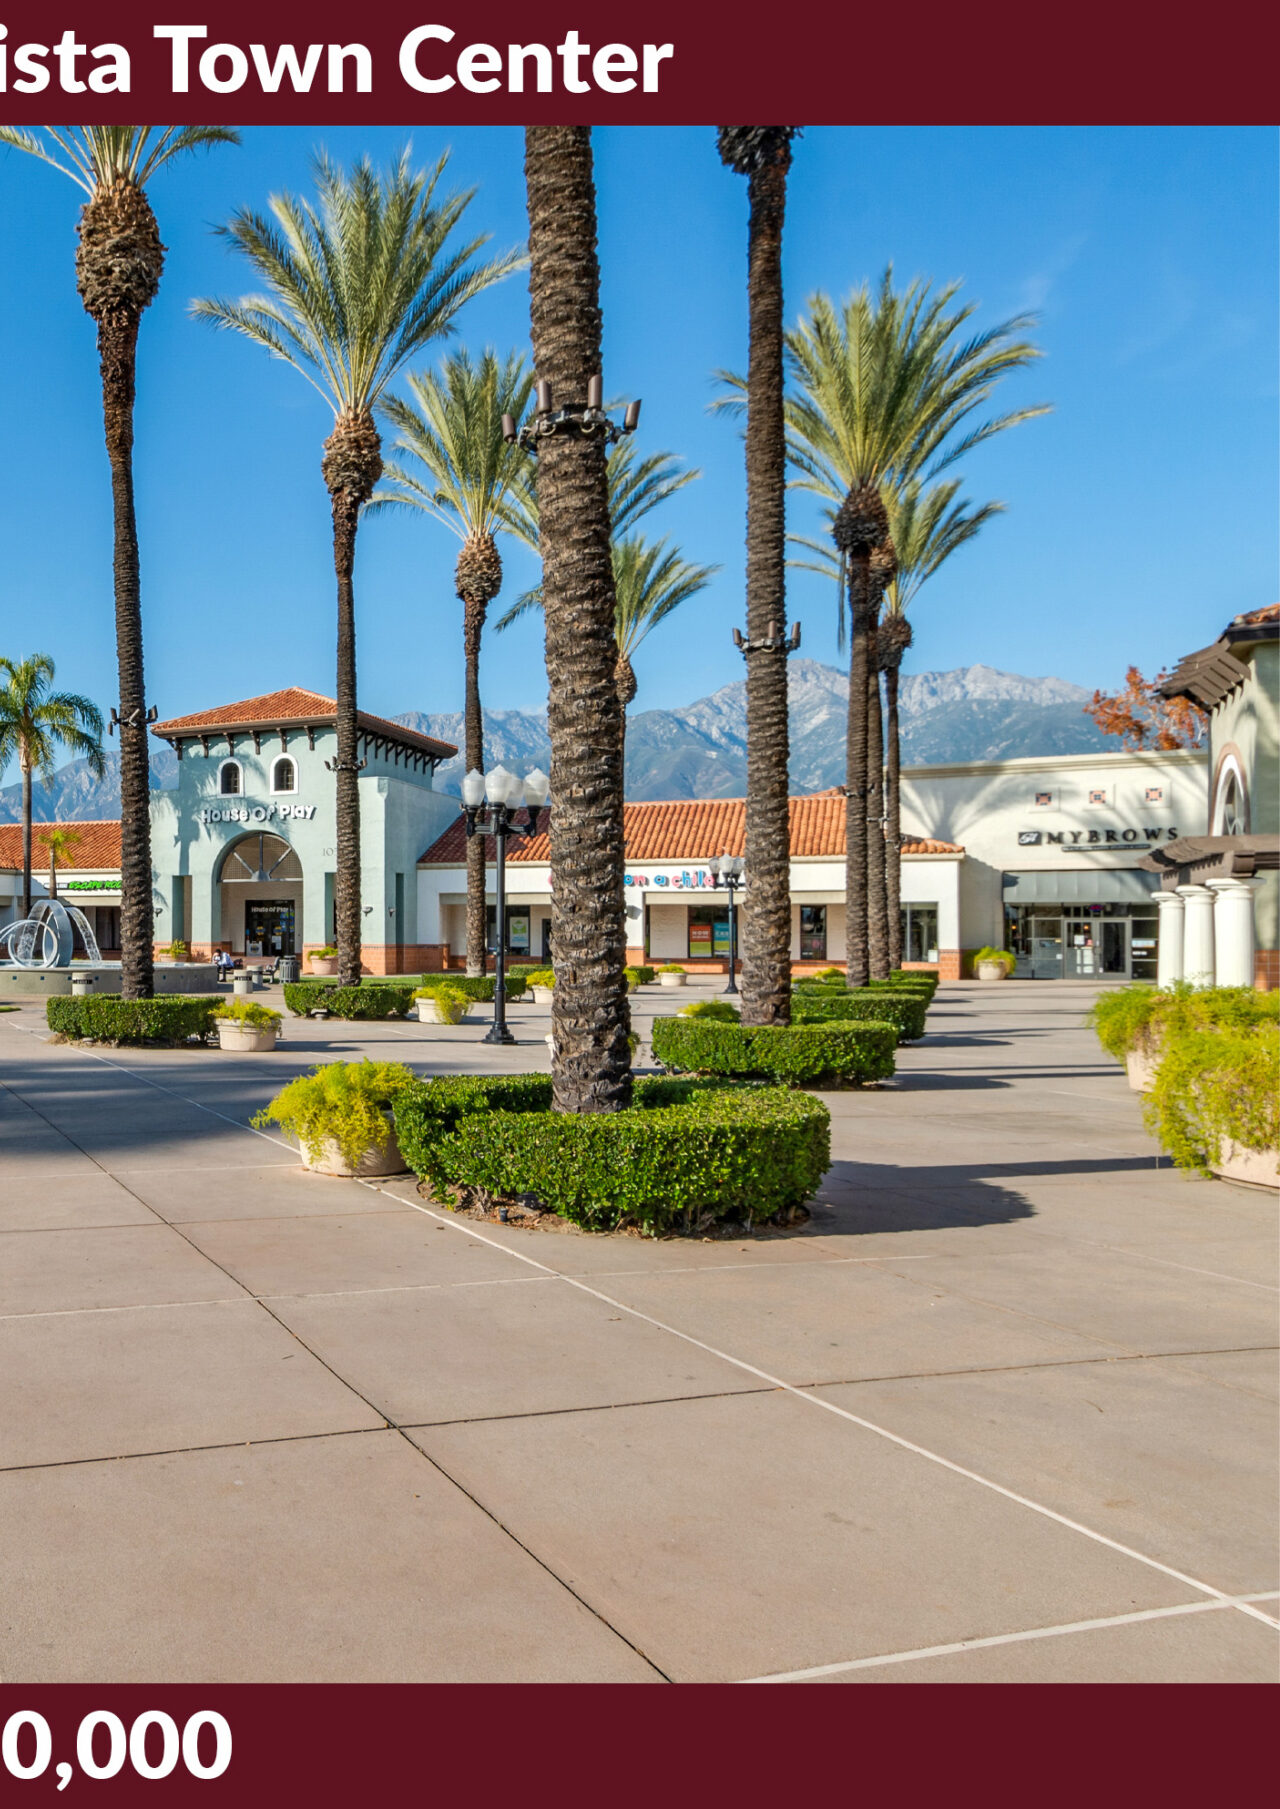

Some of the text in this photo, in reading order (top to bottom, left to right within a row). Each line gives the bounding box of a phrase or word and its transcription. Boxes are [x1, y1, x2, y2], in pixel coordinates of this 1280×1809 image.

[201, 808, 248, 823] House
[279, 804, 316, 820] Play
[68, 880, 103, 890] ESCAPE
[654, 874, 669, 887] a
